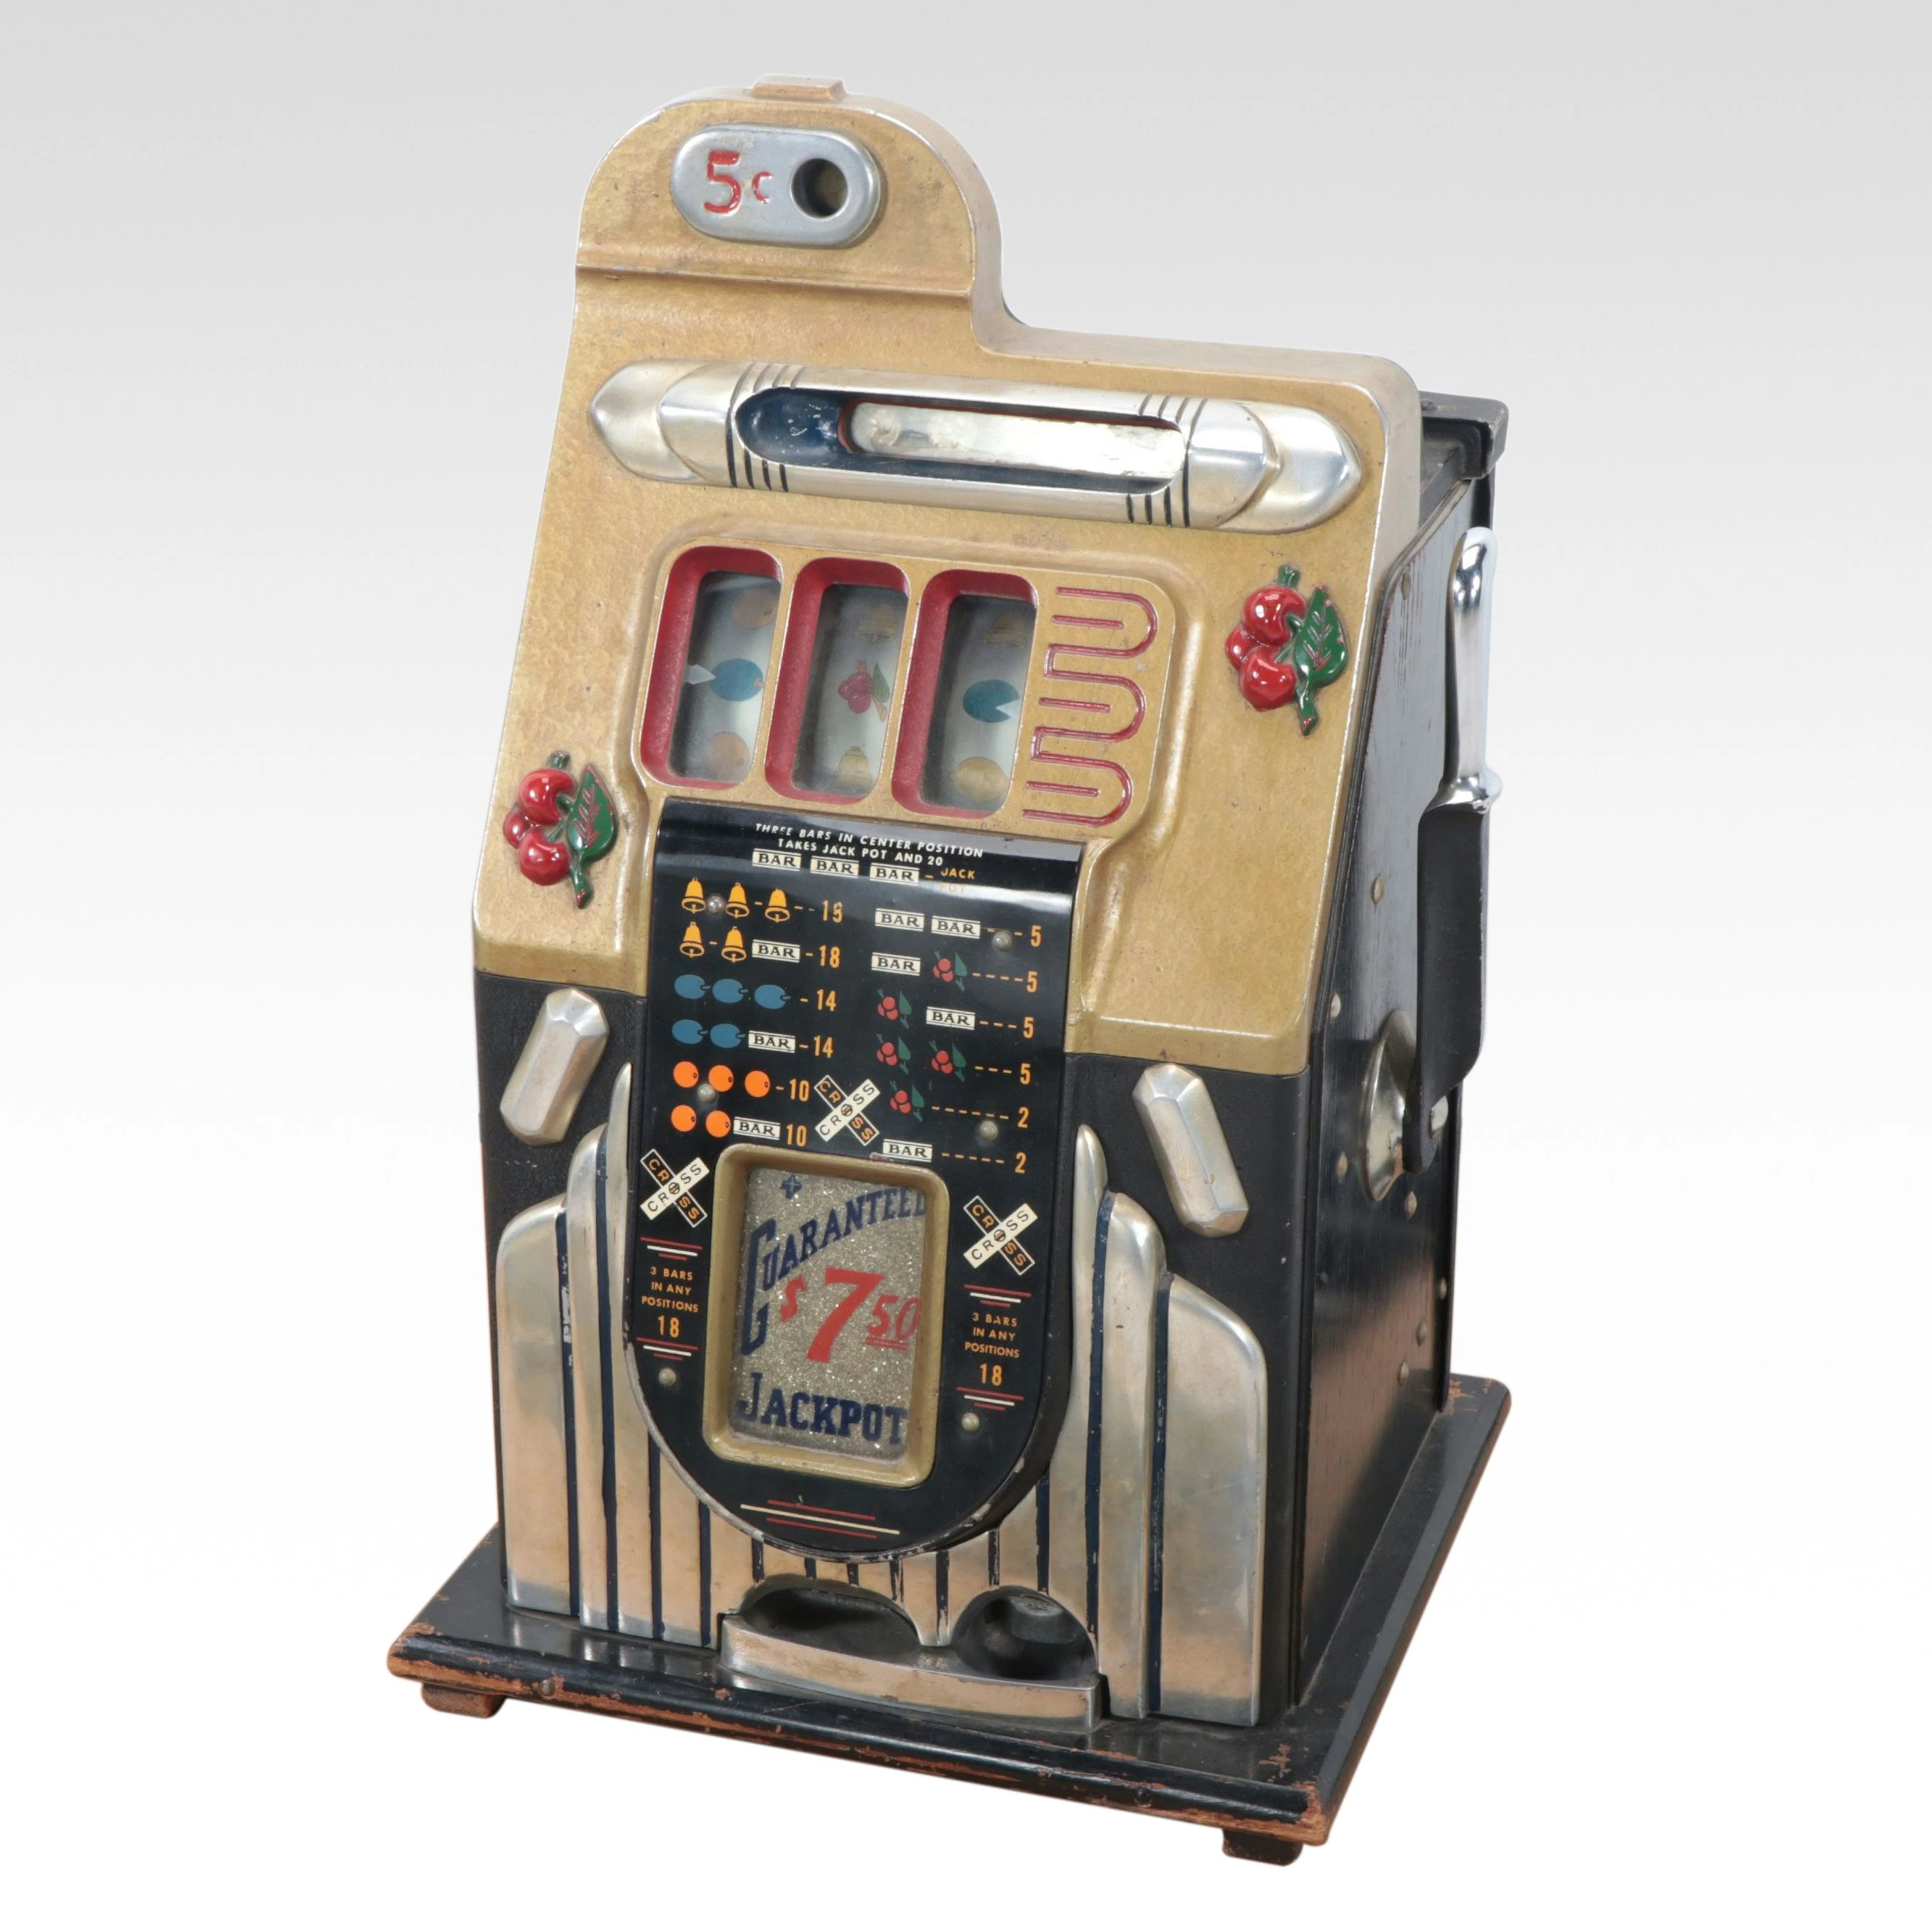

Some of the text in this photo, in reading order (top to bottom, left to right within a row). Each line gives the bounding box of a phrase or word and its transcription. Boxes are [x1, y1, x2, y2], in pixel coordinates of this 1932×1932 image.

[703, 150, 772, 215] 5c
[756, 823, 983, 857] THREE BARS IN CENTER POSITION
[778, 839, 943, 866] TAKES JACK POT AND 20
[758, 853, 975, 880] BAR BAR BAR JACK
[880, 913, 1041, 947] BAR BAR 5
[758, 944, 840, 968] BAR 18
[877, 957, 1038, 993] BAR 5
[817, 989, 836, 1011] 14
[932, 1012, 1034, 1038] BAR 5
[754, 1035, 833, 1058] BAR 14
[1020, 1063, 1030, 1085] 5
[789, 1078, 810, 1102] 10
[820, 1084, 874, 1136] CROSS
[1017, 1107, 1029, 1128] 2
[739, 1121, 807, 1147] BAR 10
[889, 1144, 1027, 1174] BAR 2
[648, 1164, 701, 1212] CROSS
[971, 1211, 1029, 1260] CROSS
[651, 1266, 693, 1280] 3 BARS
[651, 1281, 691, 1296] IN ANY
[641, 1296, 698, 1313] POSITIONS
[658, 1315, 680, 1338] 18
[973, 1312, 1017, 1327] 3 BARS
[973, 1327, 1016, 1341] IN ANY
[964, 1341, 1019, 1358] POSITIONS
[980, 1363, 1002, 1386] 18
[736, 1372, 909, 1445] JACKPOT
